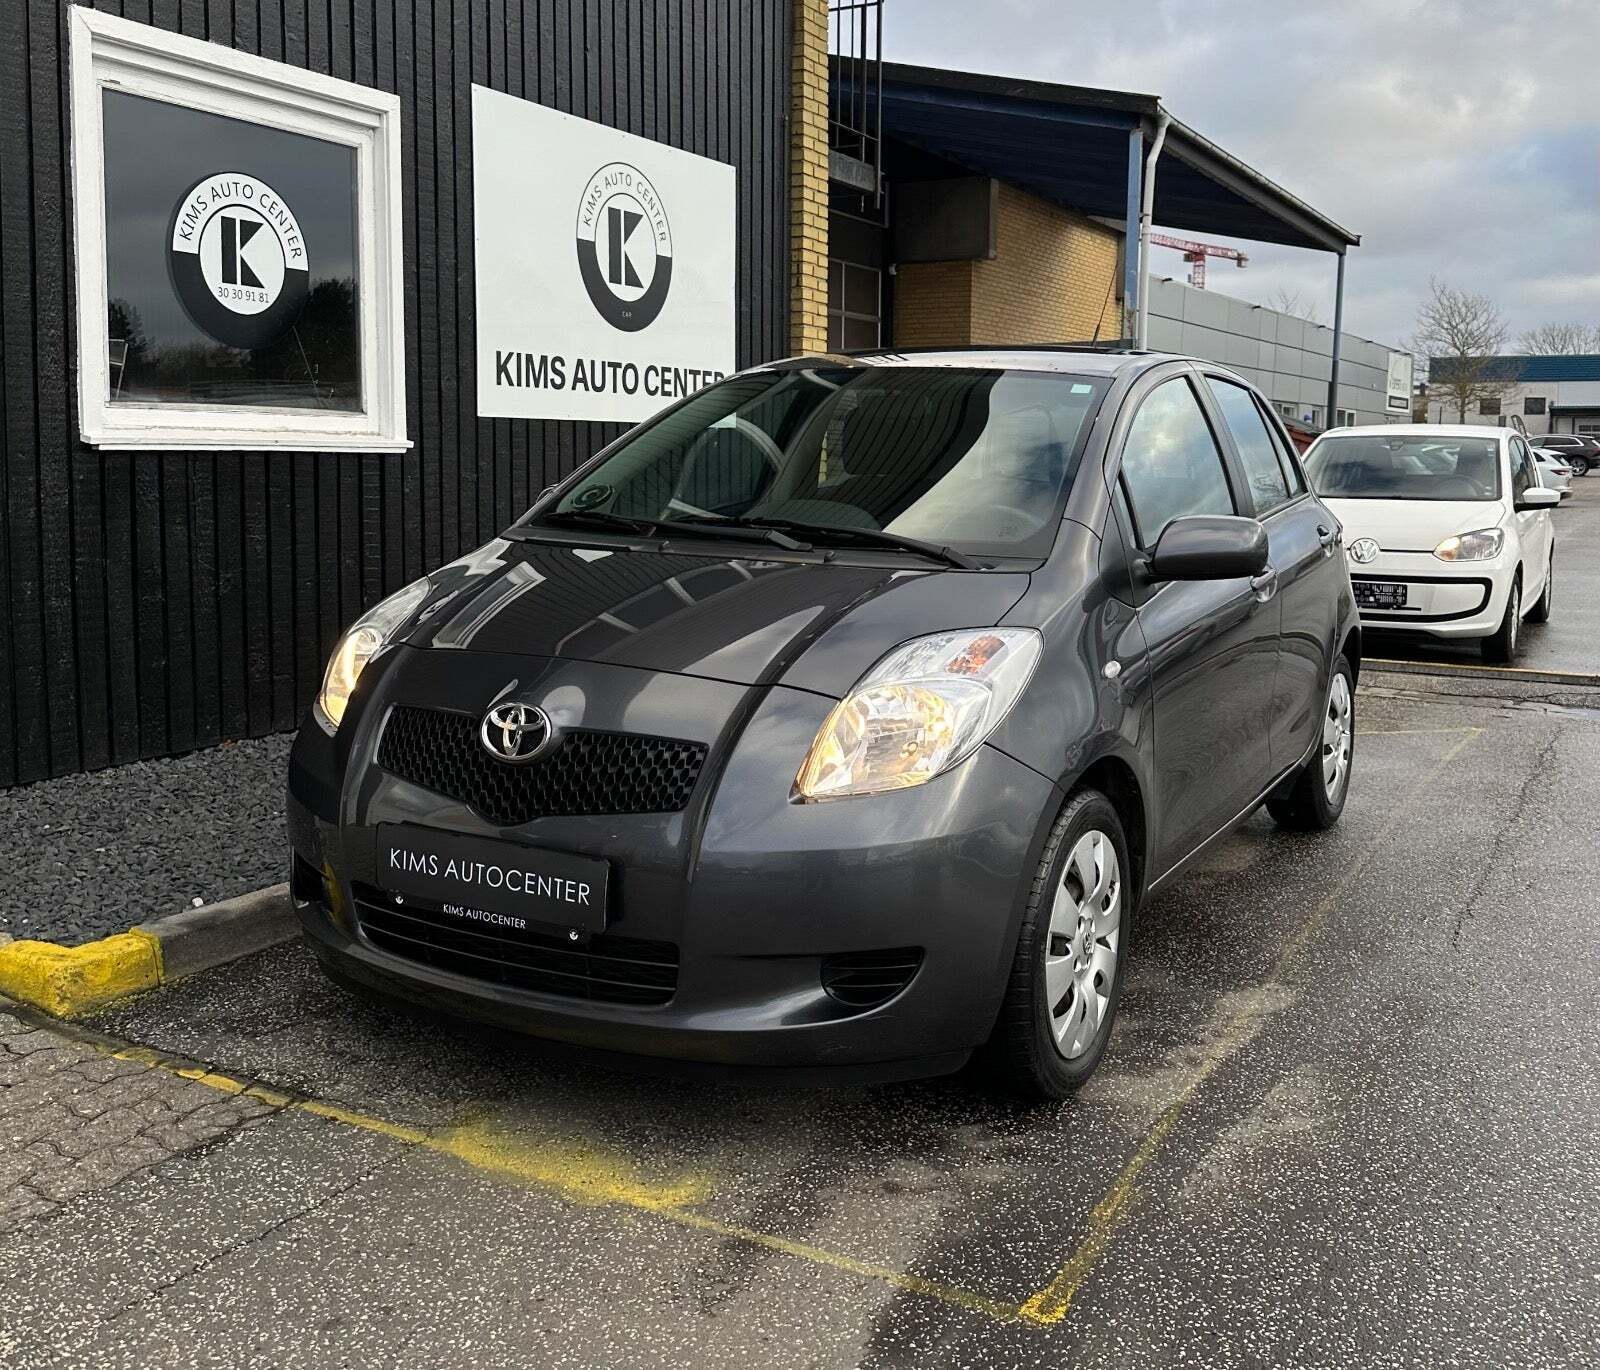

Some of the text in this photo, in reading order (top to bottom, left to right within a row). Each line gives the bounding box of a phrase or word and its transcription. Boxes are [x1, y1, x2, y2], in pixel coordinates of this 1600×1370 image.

[179, 181, 302, 259] KIMS AUTO CENTER
[583, 172, 667, 242] KIMS AUTO CENTER
[220, 215, 265, 289] K
[607, 206, 645, 289] K
[217, 286, 270, 304] 30 30 91 81
[495, 350, 566, 390] KIMS
[571, 358, 640, 395] AUTO
[390, 848, 590, 906] KIMS AUTOCENTER
[443, 903, 526, 929] KIMS AUTOCENTER
